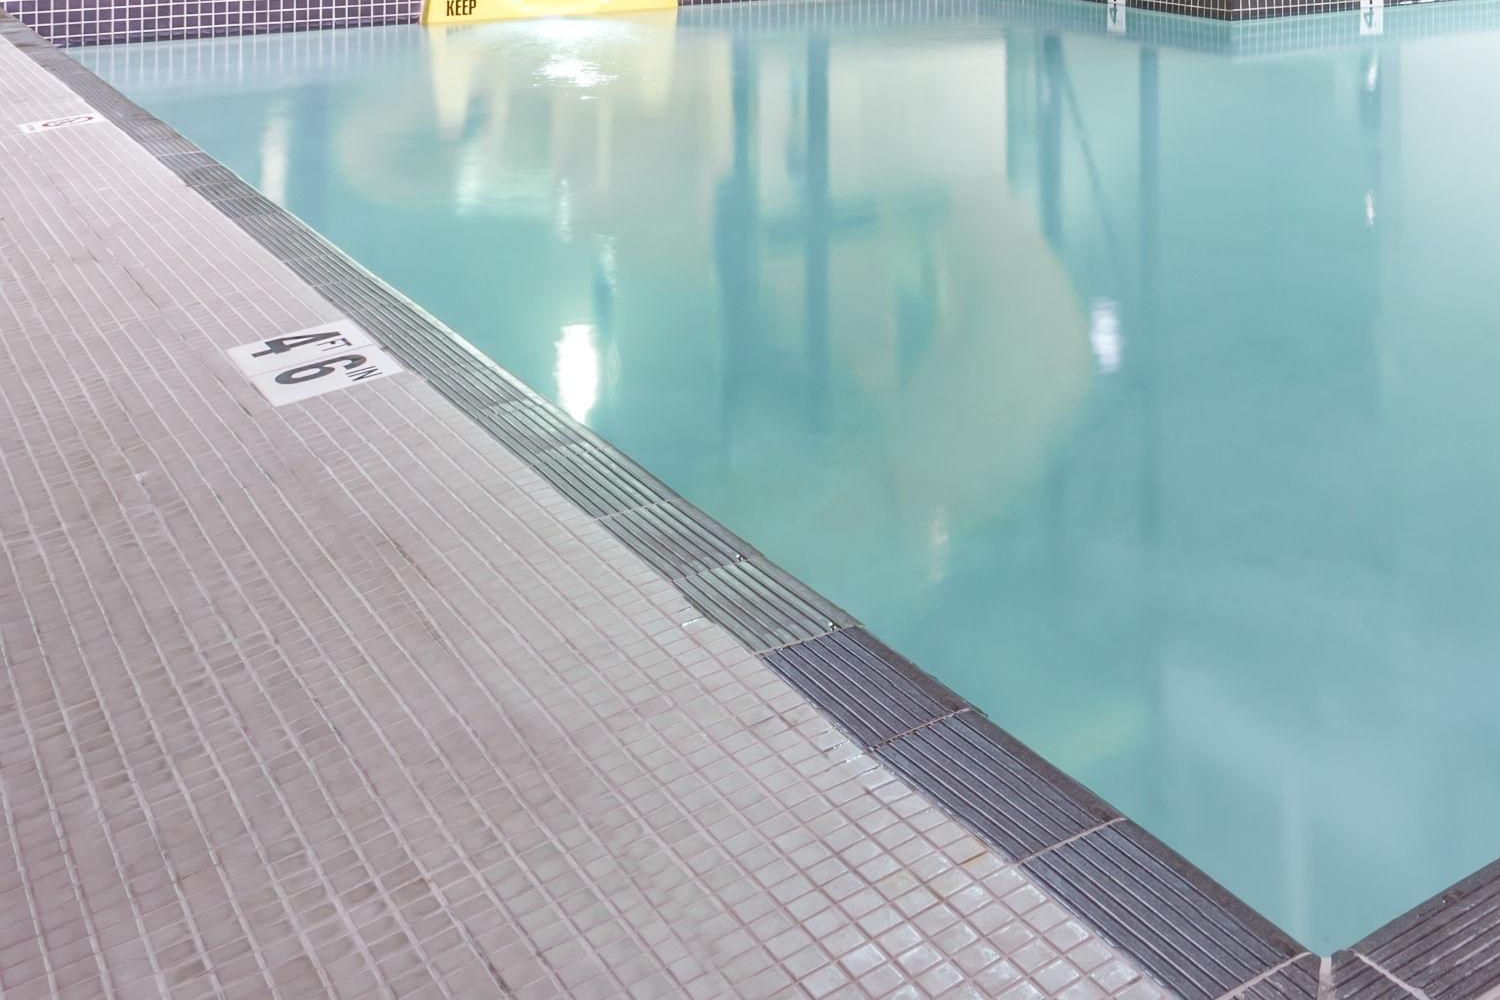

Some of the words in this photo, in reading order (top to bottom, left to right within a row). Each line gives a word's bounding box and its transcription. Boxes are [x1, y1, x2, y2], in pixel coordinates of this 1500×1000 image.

[446, 0, 477, 17] KEEP
[251, 331, 343, 358] 4
[274, 354, 367, 385] 6
[345, 365, 383, 382] IN
